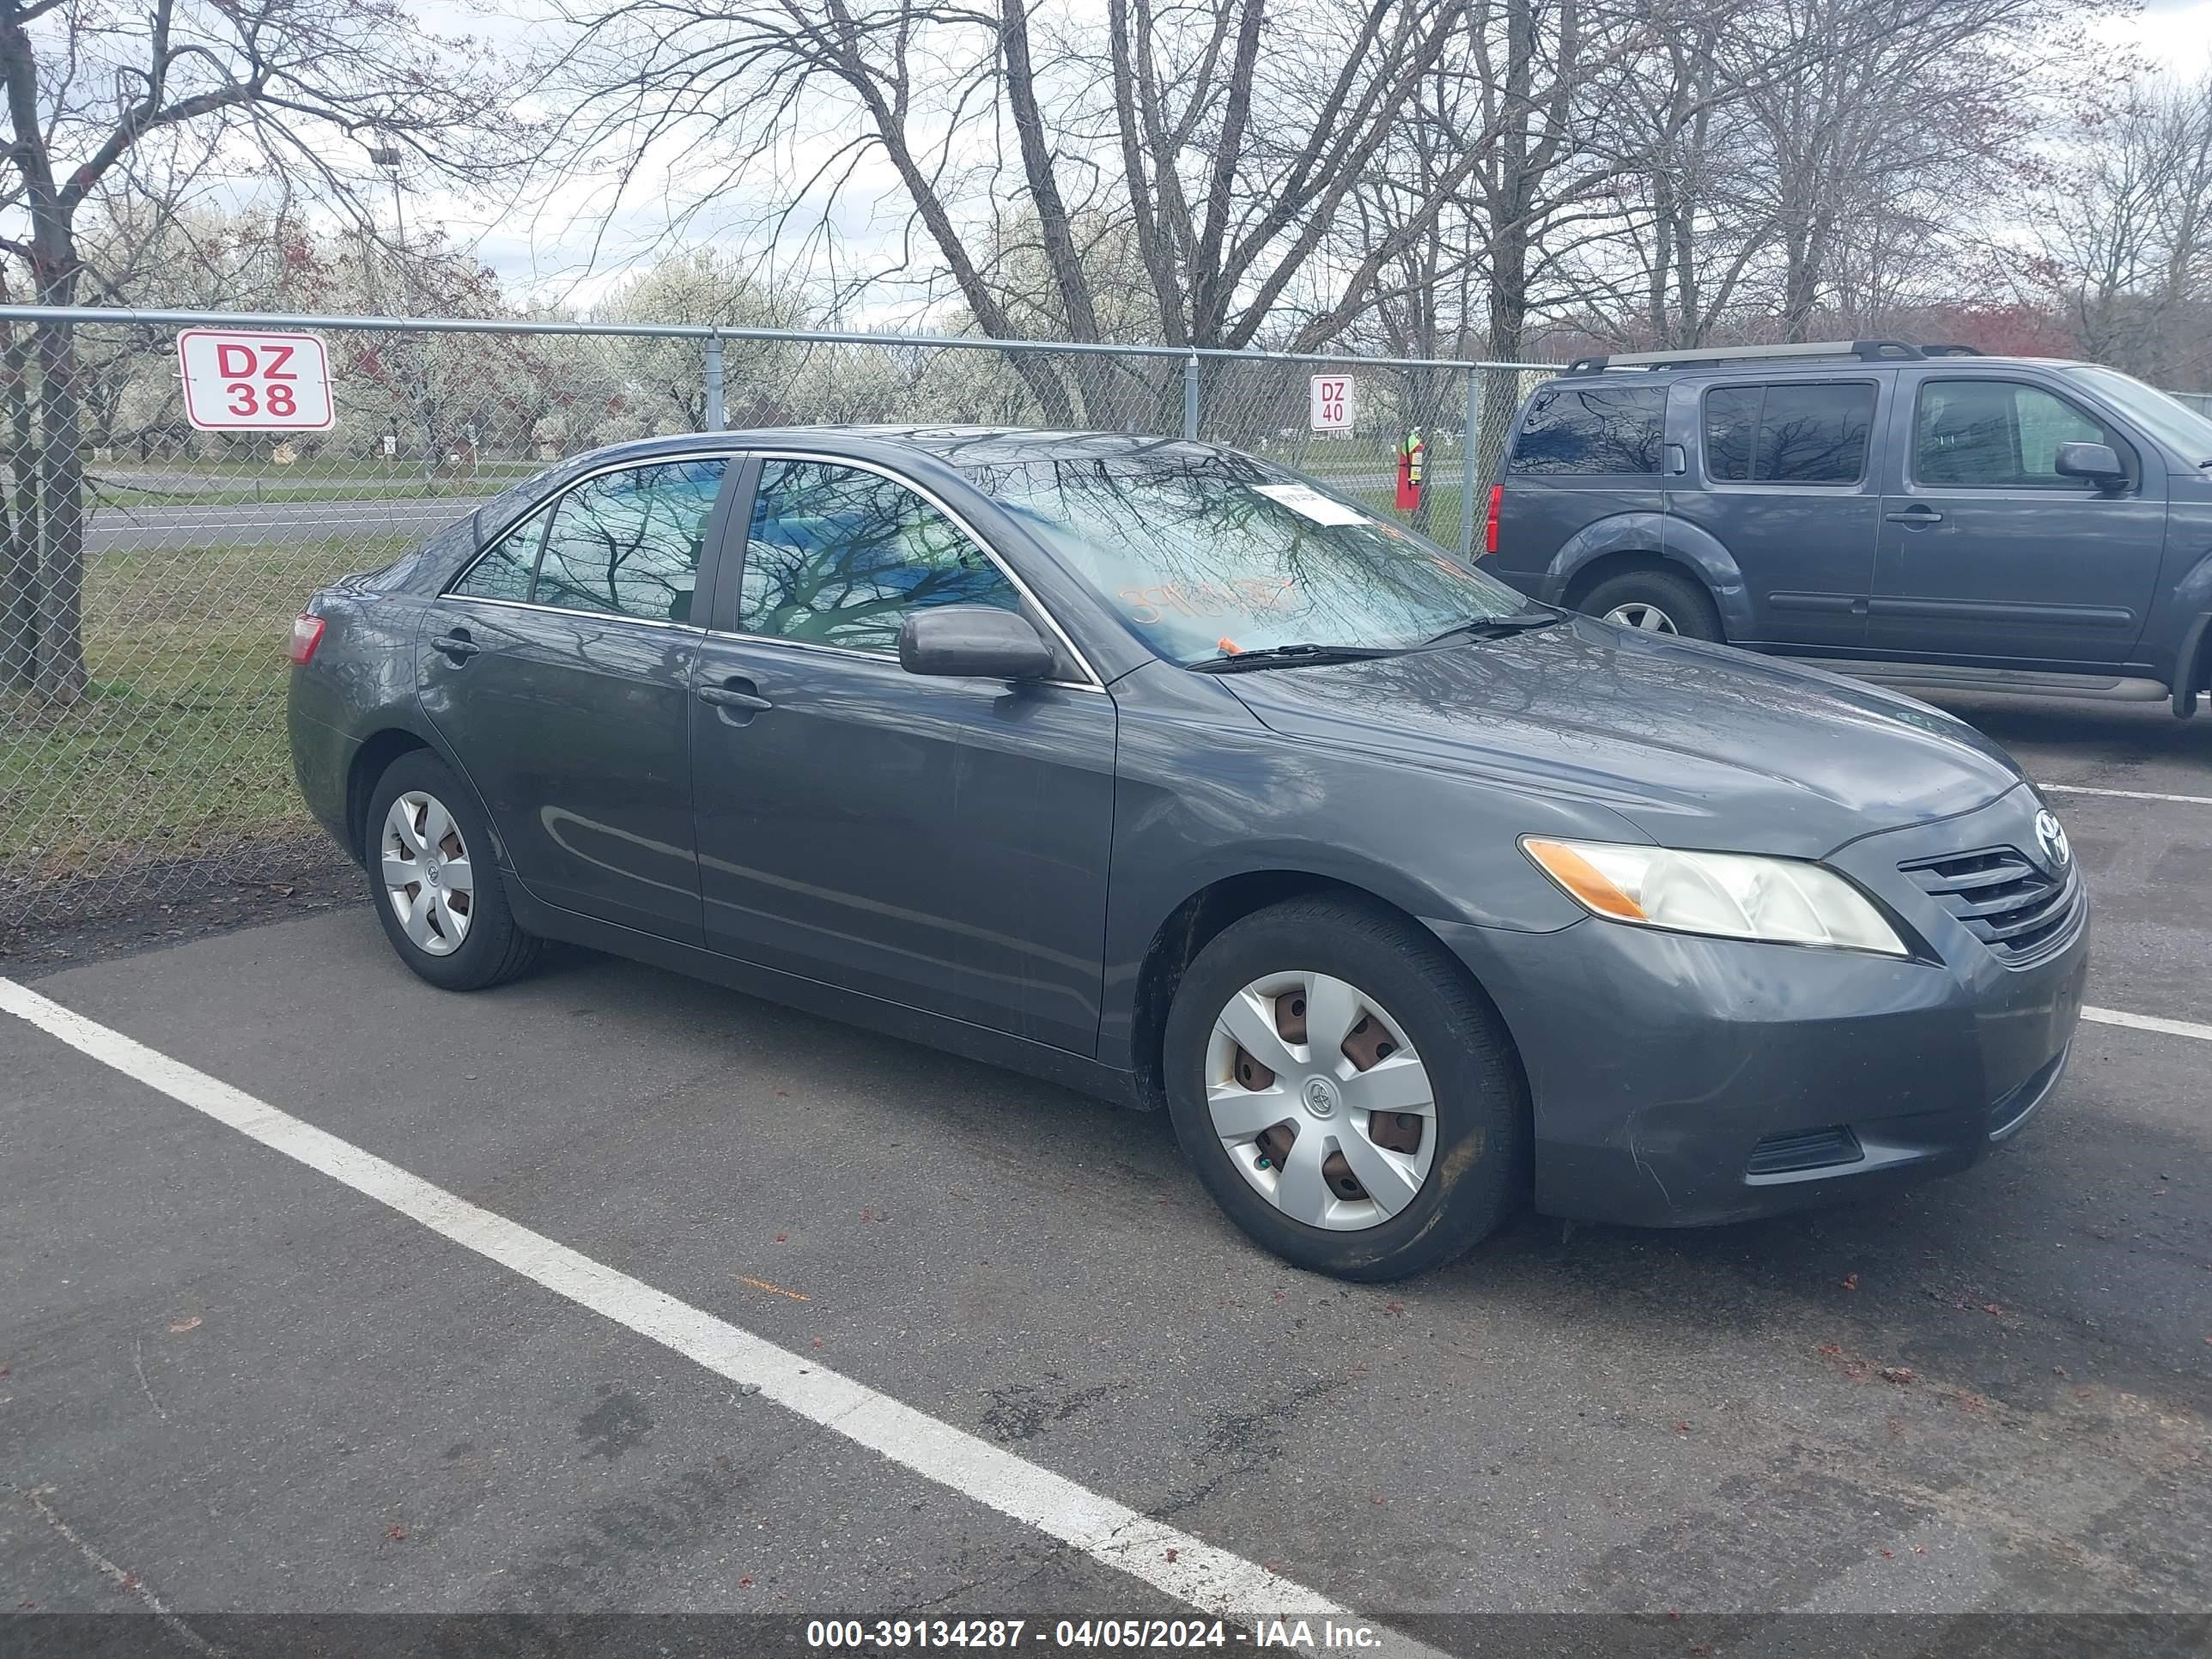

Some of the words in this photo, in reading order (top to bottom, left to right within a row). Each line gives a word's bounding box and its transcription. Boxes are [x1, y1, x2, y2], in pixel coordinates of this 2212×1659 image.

[216, 343, 297, 380] DZ
[226, 383, 296, 416] 38
[1322, 382, 1345, 402] DZ
[1322, 403, 1343, 422] 40
